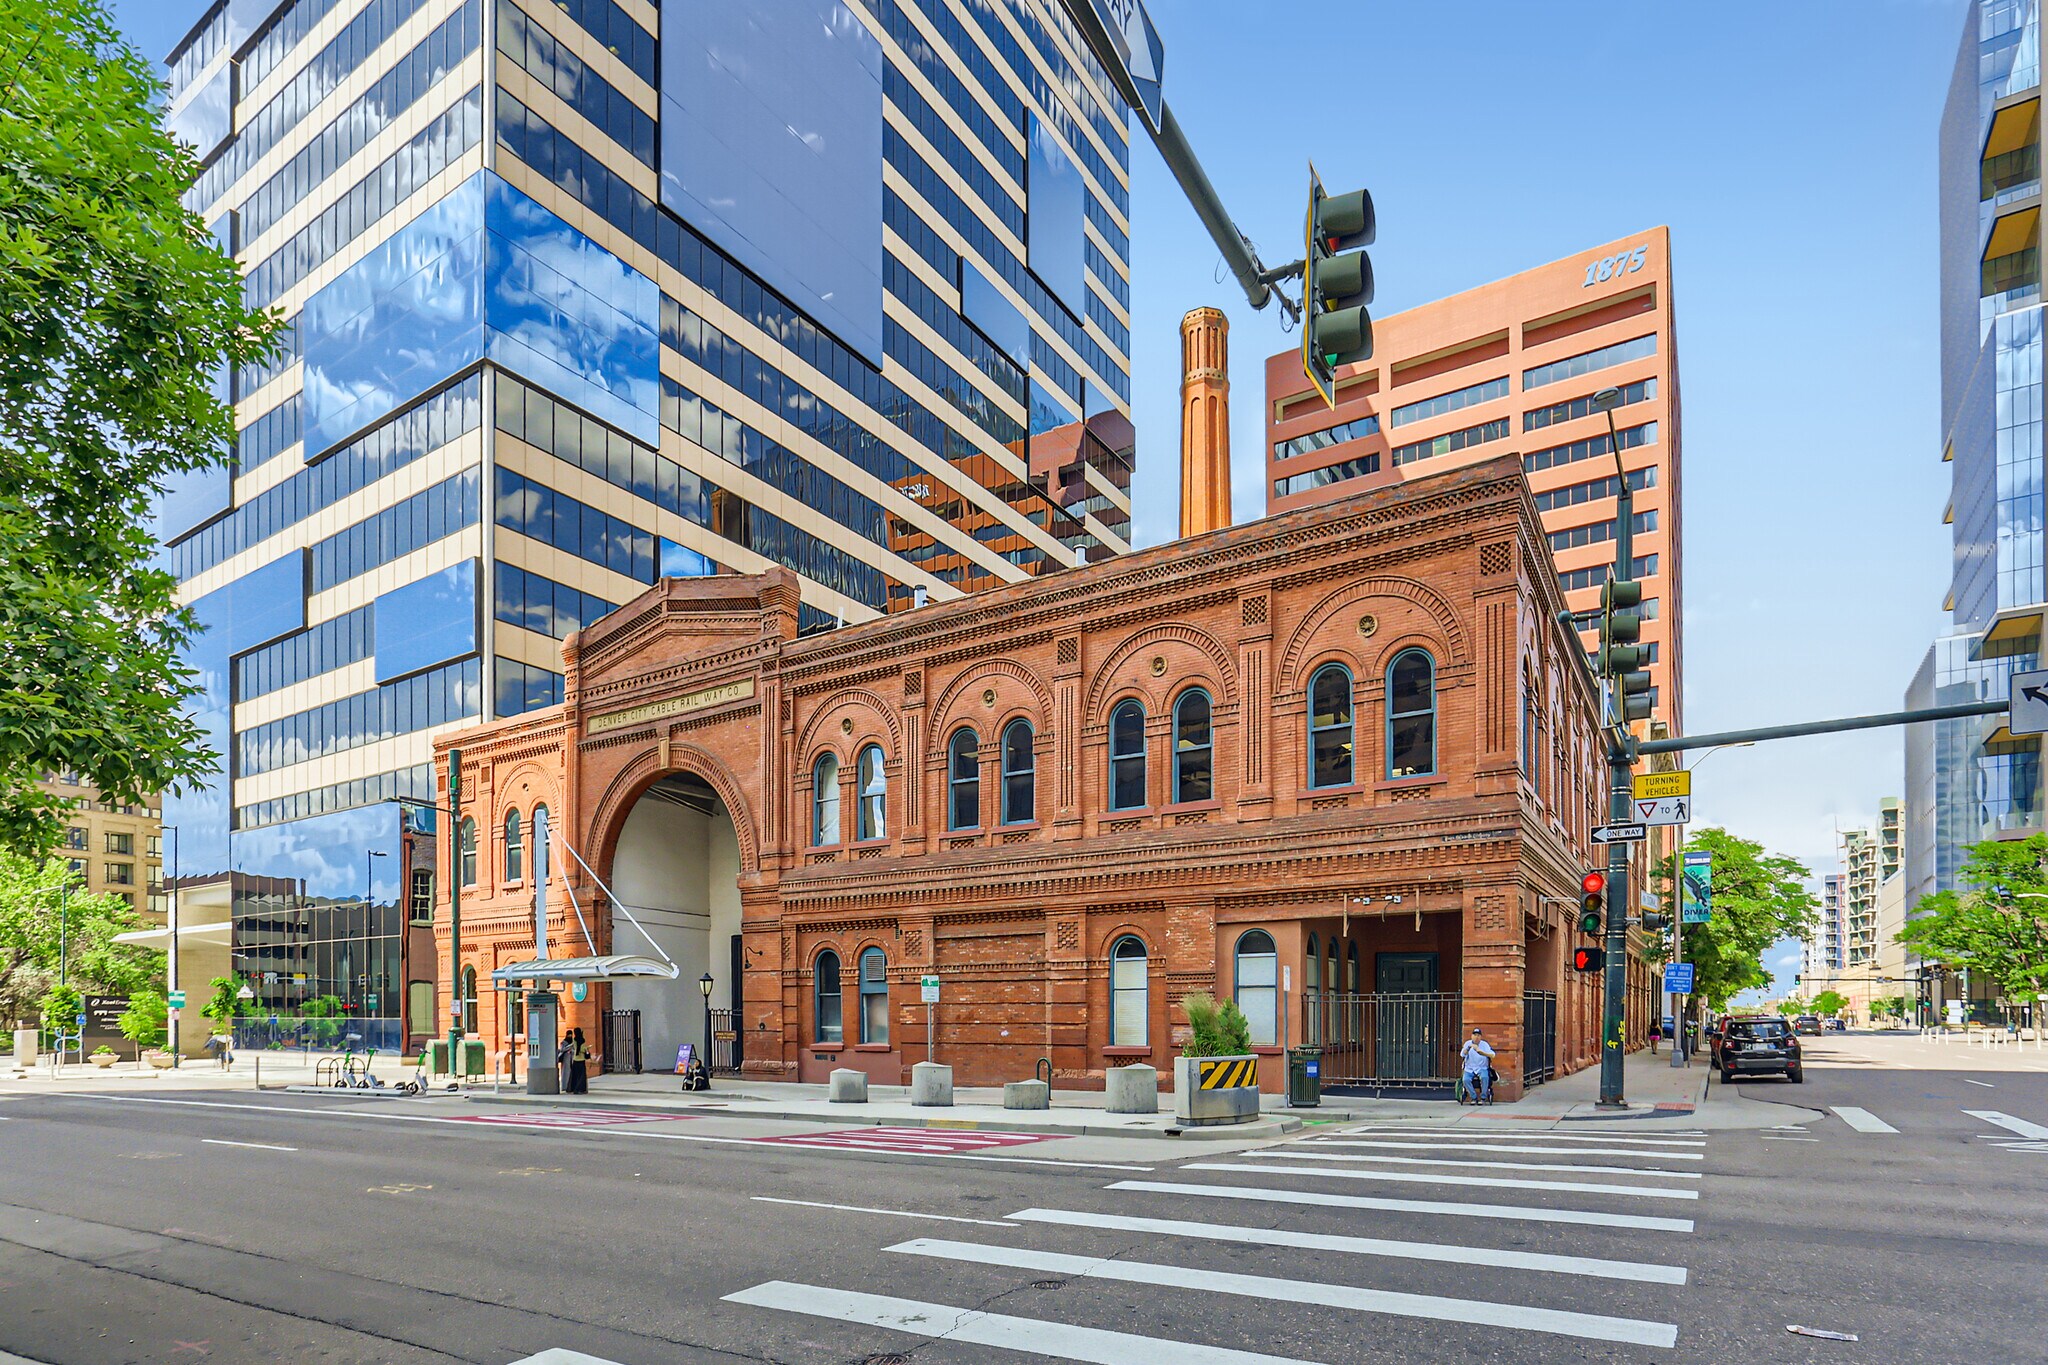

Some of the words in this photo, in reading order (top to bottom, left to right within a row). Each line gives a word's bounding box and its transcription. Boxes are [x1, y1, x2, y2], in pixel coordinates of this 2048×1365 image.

[1107, 0, 1132, 36] AY
[1582, 244, 1649, 288] 1875
[598, 713, 627, 728] DENVER
[631, 707, 648, 720] CITY
[651, 700, 676, 716] CABLE
[680, 696, 699, 709] RAIL
[704, 689, 723, 703] WAY
[727, 685, 739, 697] CO
[1645, 776, 1680, 786] TURNING
[1645, 786, 1680, 796] VEHICLES
[1606, 830, 1621, 838] ONE
[1624, 828, 1641, 836] WAY
[1684, 908, 1709, 916] DIVER
